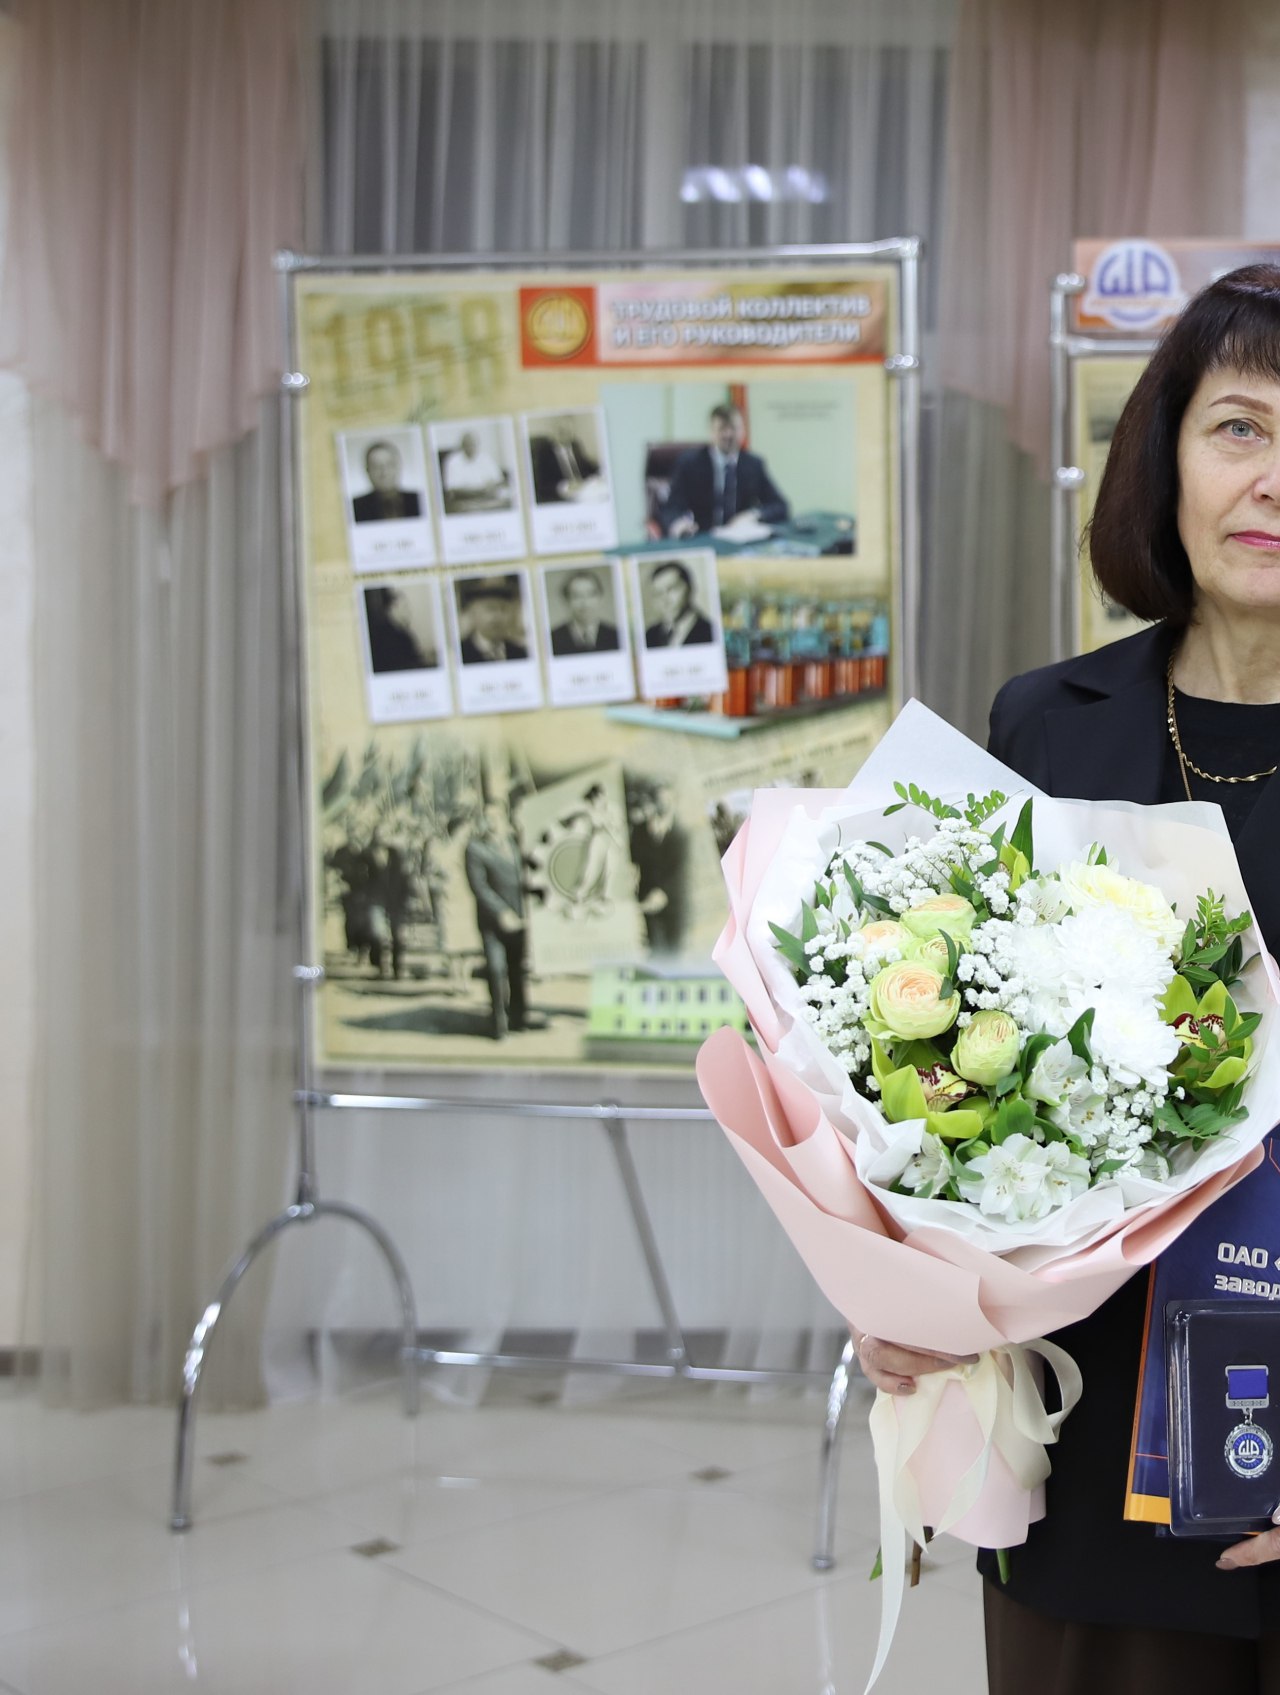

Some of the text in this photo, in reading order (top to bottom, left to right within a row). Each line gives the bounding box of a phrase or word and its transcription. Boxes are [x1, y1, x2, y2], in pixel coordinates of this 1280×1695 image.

[612, 294, 872, 322] ТРУДОВОЙ КОЛЛЕКТИВ
[612, 320, 861, 348] И ЕГО РУКОВОДИТЕЛИ
[1217, 1242, 1269, 1269] ОАО
